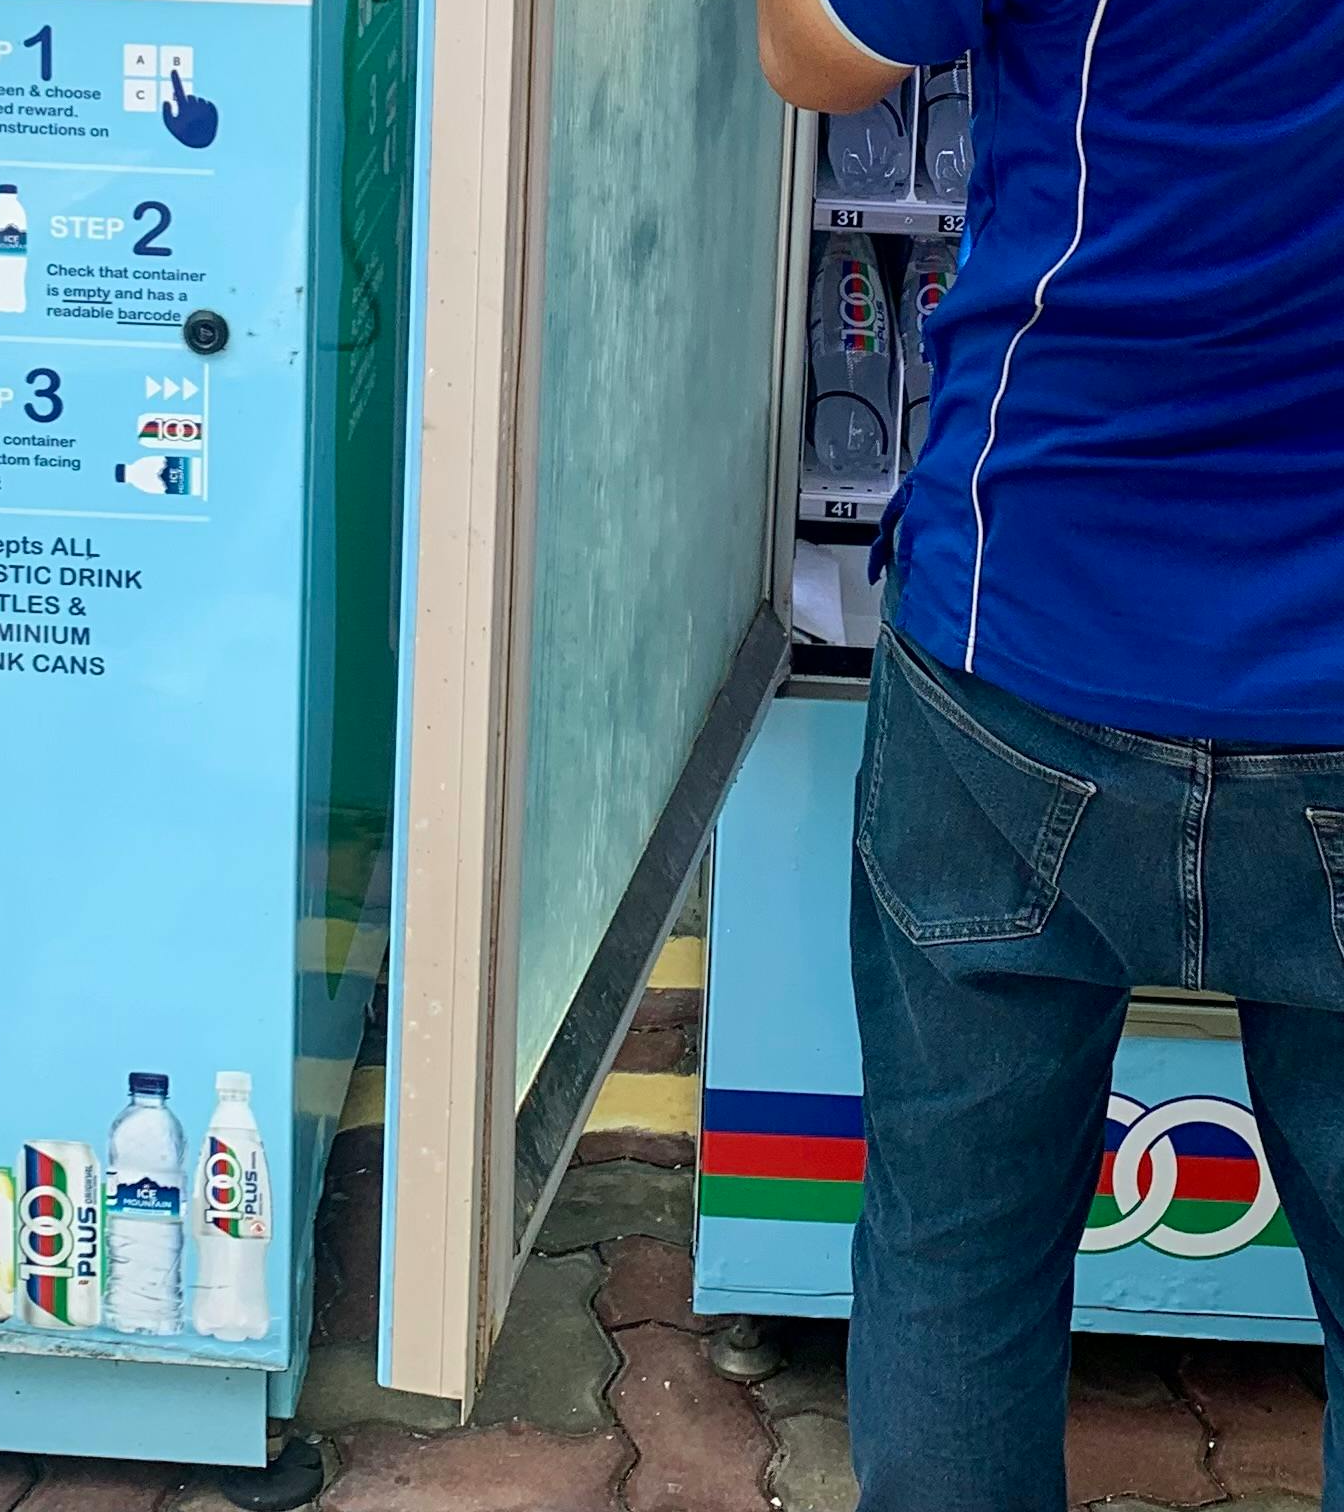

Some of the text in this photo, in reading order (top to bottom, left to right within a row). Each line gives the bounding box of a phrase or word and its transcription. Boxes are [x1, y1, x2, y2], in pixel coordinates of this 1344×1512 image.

[23, 25, 52, 82] 1
[30, 85, 41, 98] &
[45, 86, 101, 100] choose
[18, 103, 78, 118] reward.
[91, 126, 109, 138] on
[836, 210, 859, 226] 31
[943, 216, 964, 231] 32
[50, 200, 172, 256] STEP 2
[47, 264, 206, 282] Check that container
[47, 285, 187, 302] is empty and has a
[47, 305, 181, 322] readable barcode
[24, 368, 63, 423] 3
[3, 432, 76, 448] container
[34, 455, 81, 471] facing
[831, 501, 854, 517] 41
[51, 537, 100, 557] ALL
[60, 567, 143, 589] DRINK
[68, 597, 86, 616] &
[32, 654, 105, 676] CANS
[136, 1188, 157, 1200] ICE
[204, 1152, 243, 1224] 100
[244, 1170, 258, 1215] PLUS
[123, 1198, 172, 1209] MOUNTAIN
[19, 1185, 74, 1281] 100
[77, 1205, 97, 1278] PLUS
